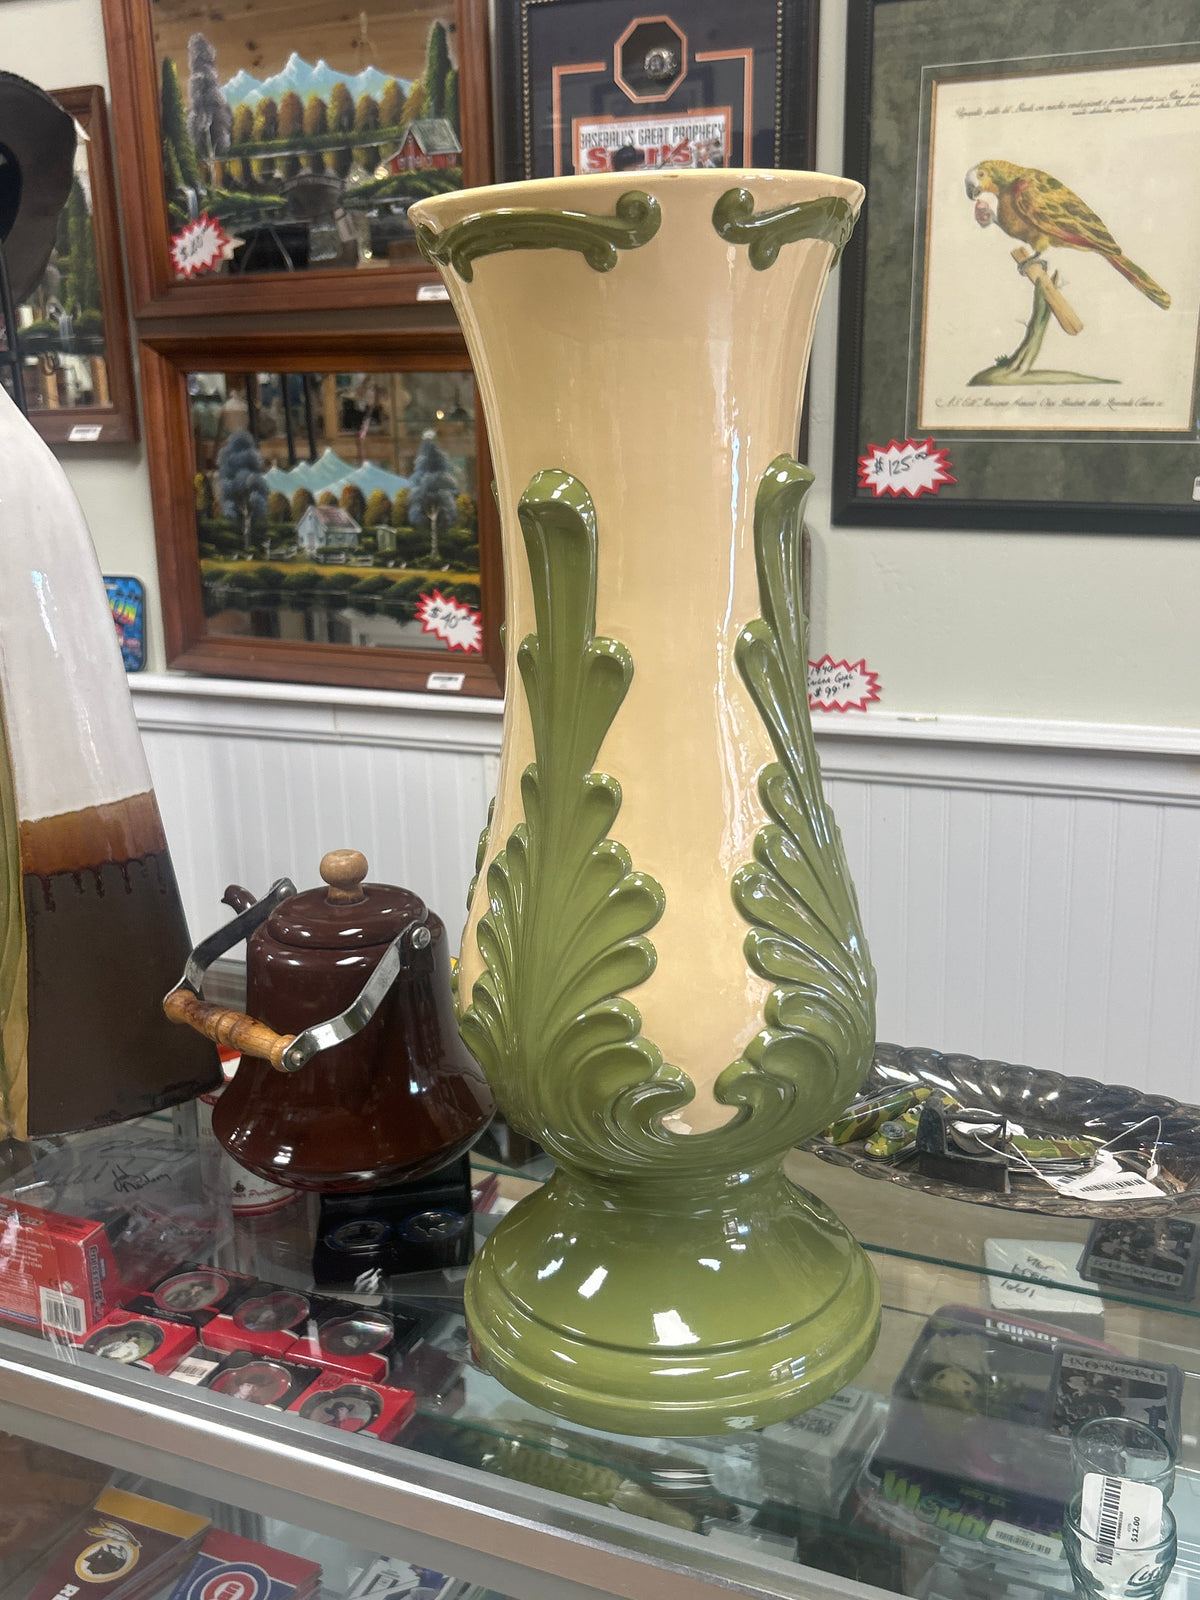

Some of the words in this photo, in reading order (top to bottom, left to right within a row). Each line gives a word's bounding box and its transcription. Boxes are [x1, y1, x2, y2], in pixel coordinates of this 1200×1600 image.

[638, 127, 669, 146] GREAT
[672, 122, 725, 145] PROPHECY
[1130, 1515, 1142, 1543] $12.00
